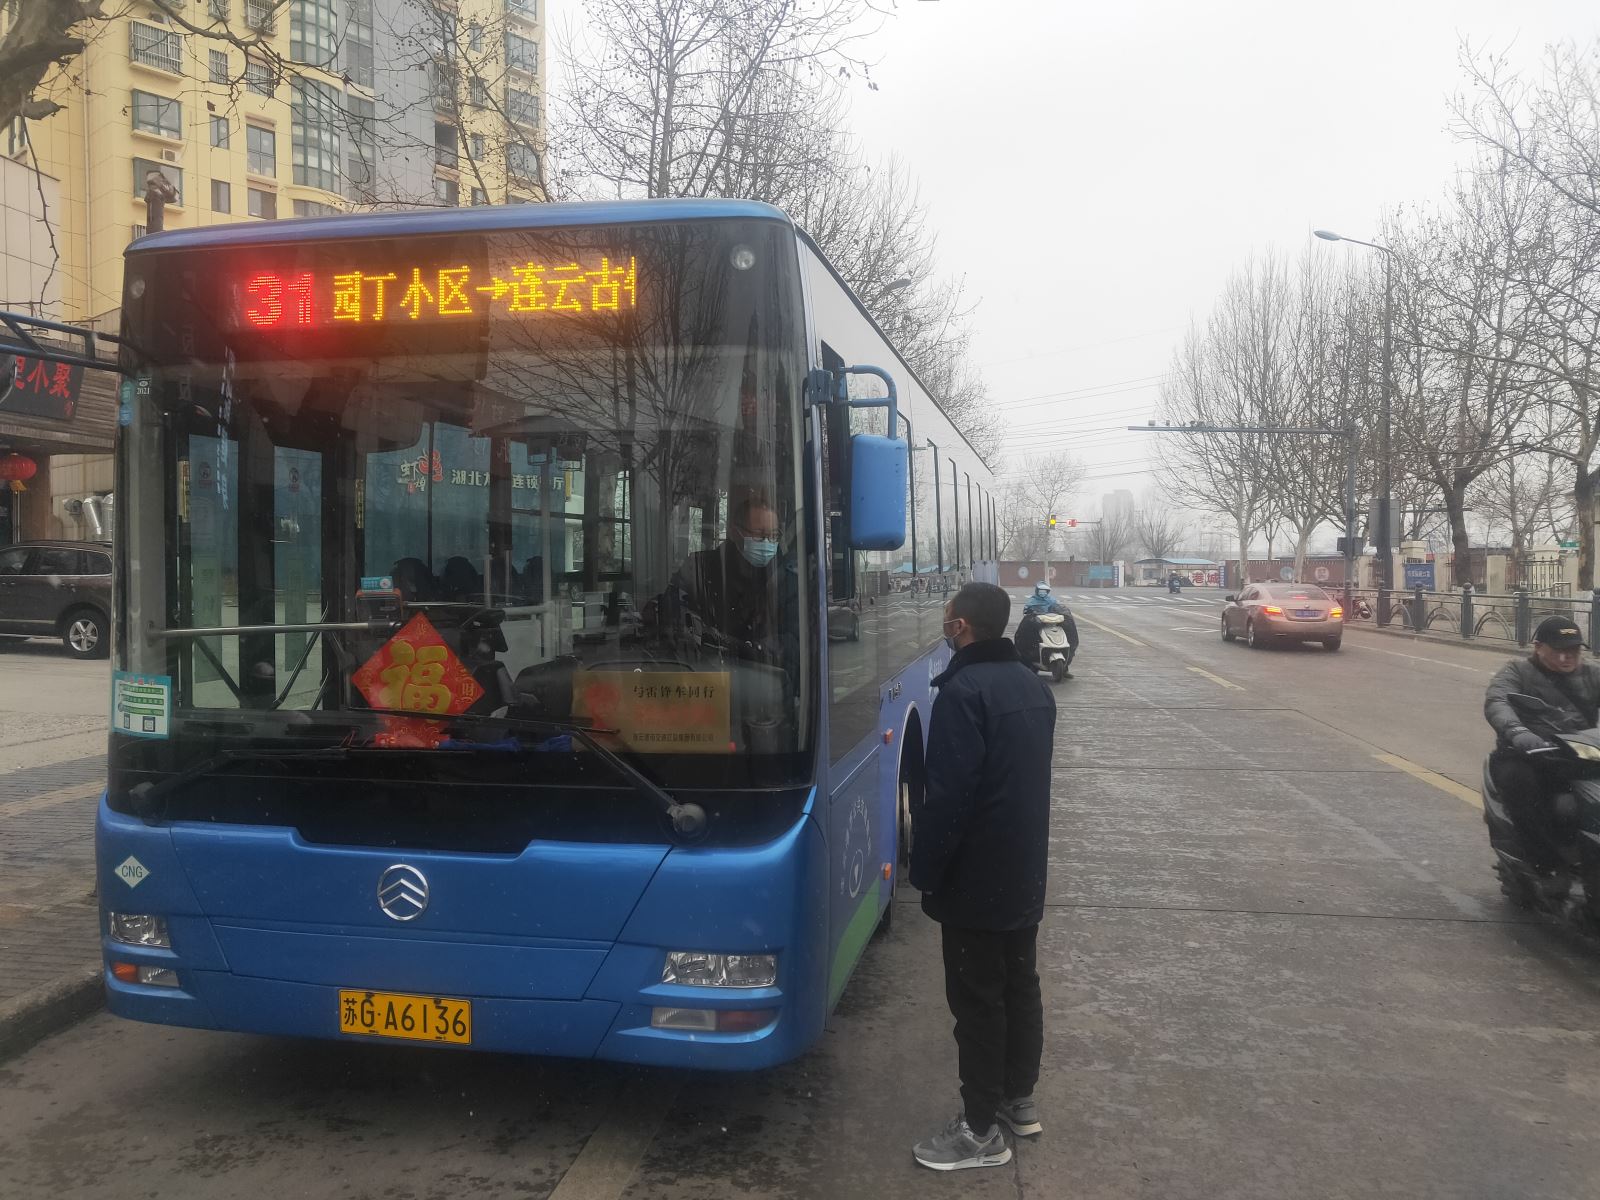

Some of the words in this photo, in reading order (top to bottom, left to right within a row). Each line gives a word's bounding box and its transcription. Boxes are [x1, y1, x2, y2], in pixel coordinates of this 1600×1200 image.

[247, 273, 311, 325] 31
[136, 387, 150, 395] 2021
[451, 469, 565, 490] 湖北连锁厅
[378, 639, 453, 716] 福
[121, 865, 143, 878] CNG
[343, 997, 467, 1037] 苏G·A6136
